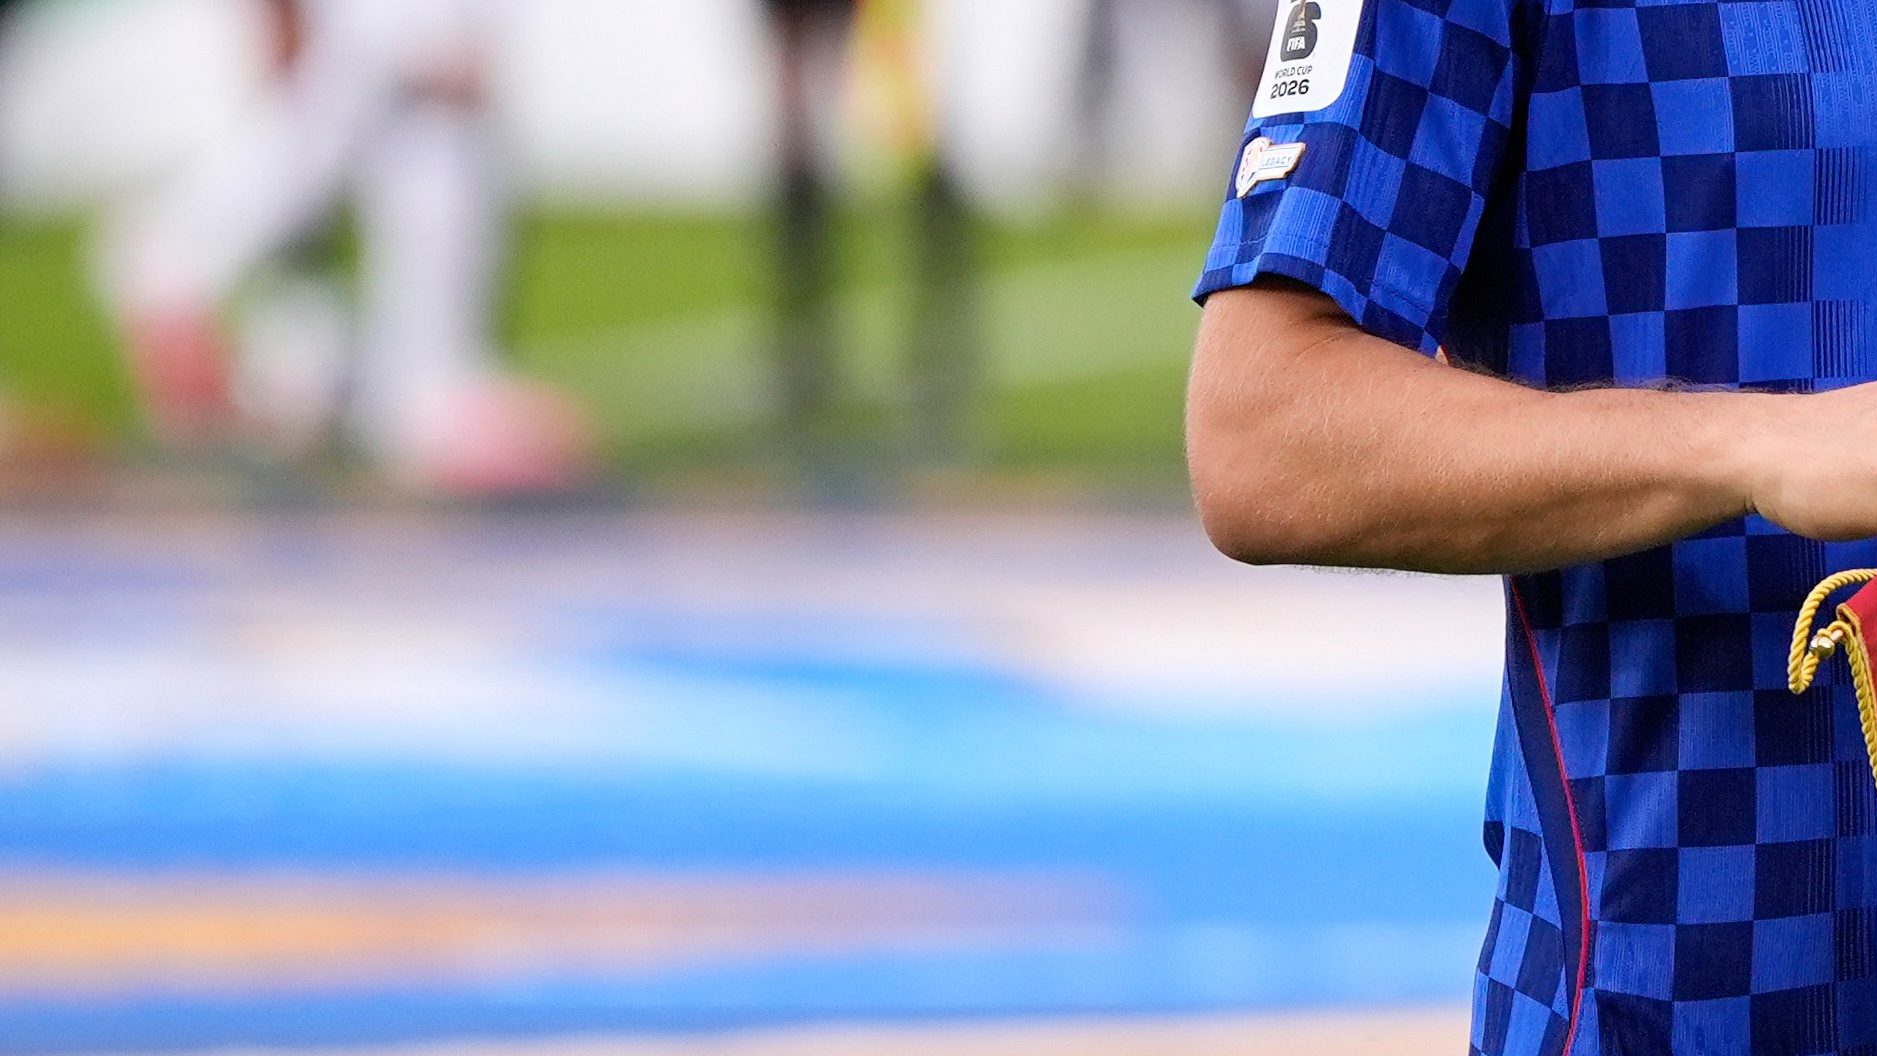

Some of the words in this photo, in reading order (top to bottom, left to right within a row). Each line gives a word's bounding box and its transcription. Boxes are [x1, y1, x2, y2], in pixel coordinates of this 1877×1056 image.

[1286, 36, 1306, 52] FIFA
[1297, 65, 1313, 76] CUP
[1270, 79, 1310, 99] 2026
